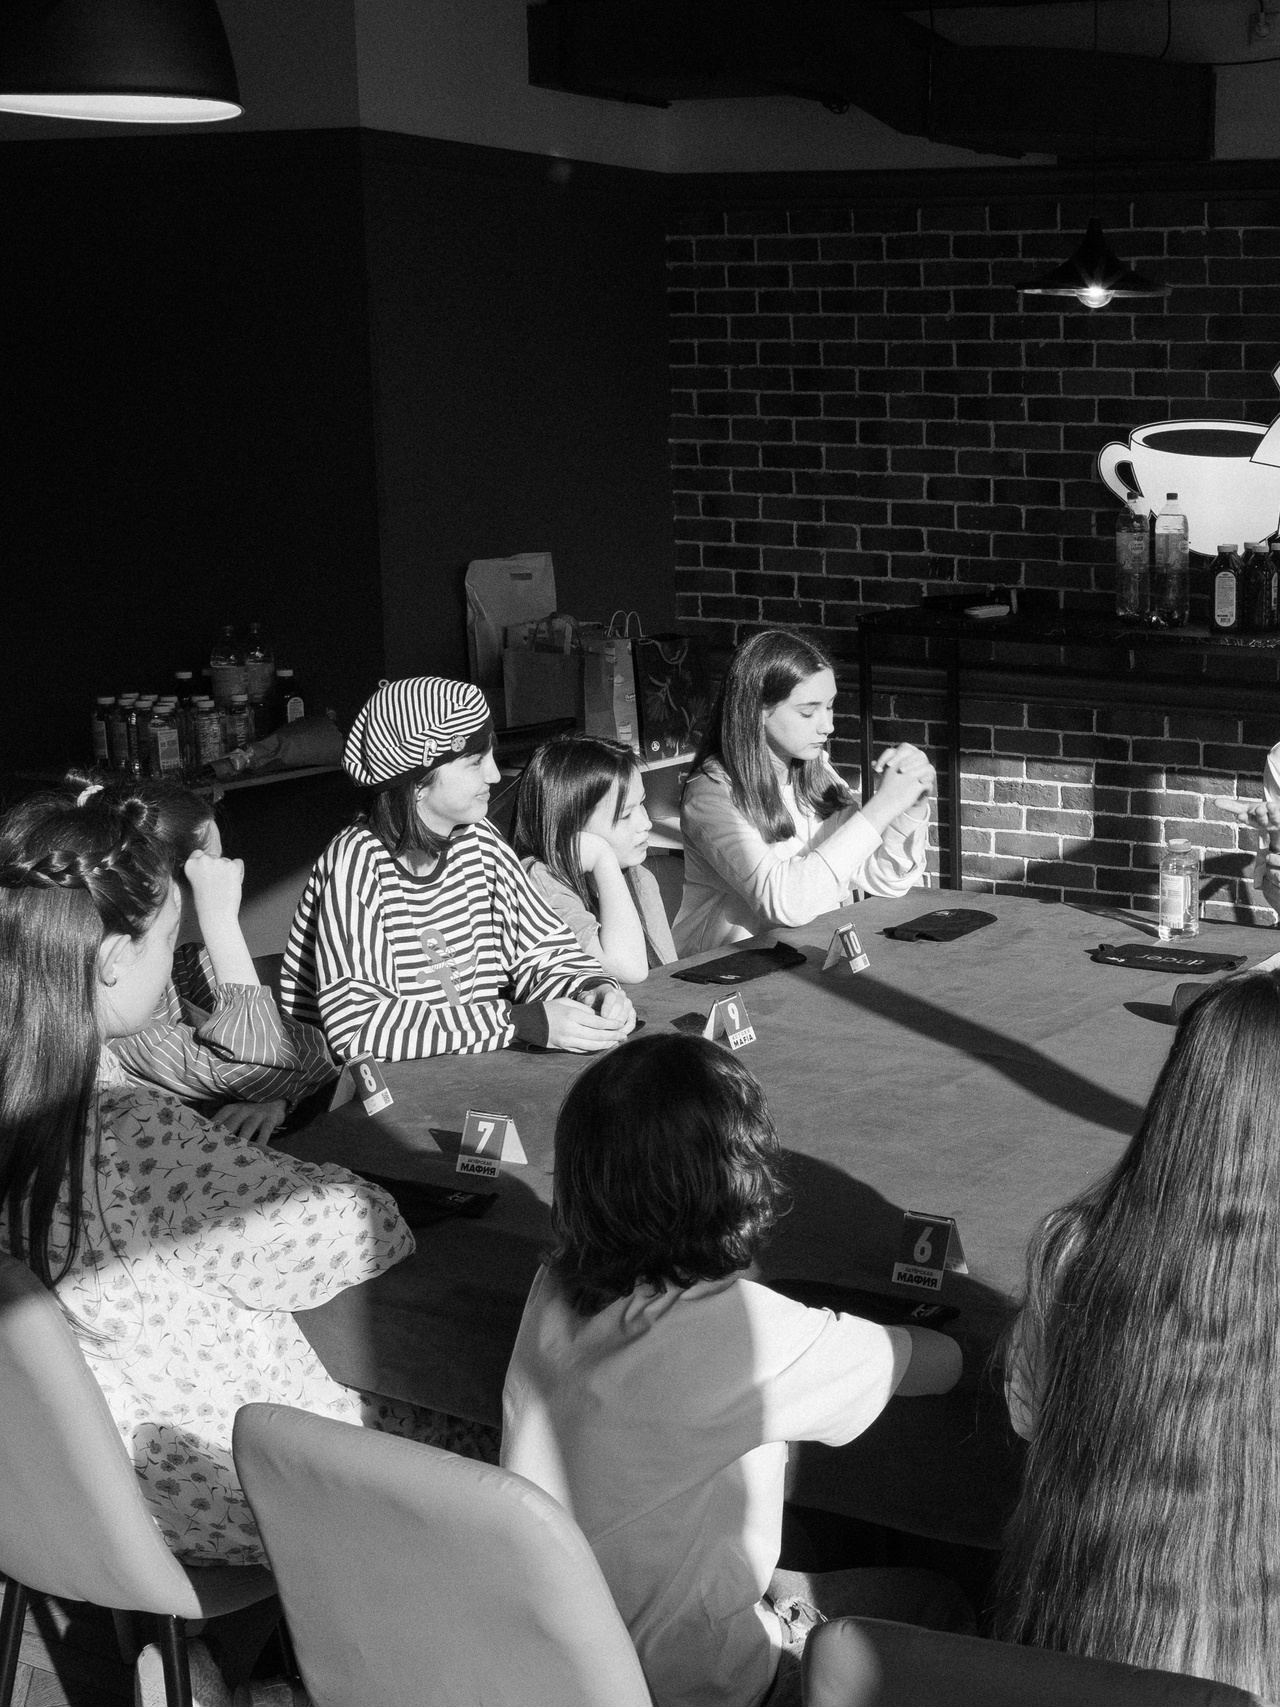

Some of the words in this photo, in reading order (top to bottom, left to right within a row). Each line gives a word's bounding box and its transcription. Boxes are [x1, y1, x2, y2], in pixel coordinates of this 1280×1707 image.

[843, 930, 862, 957] 10
[727, 1002, 740, 1030] 9
[733, 1034, 754, 1048] MAFIA
[359, 1063, 377, 1093] 8
[475, 1120, 495, 1154] 7
[460, 1162, 497, 1176] МАФИЯ
[913, 1226, 934, 1263] 6
[896, 1271, 938, 1288] МАФИЯ
